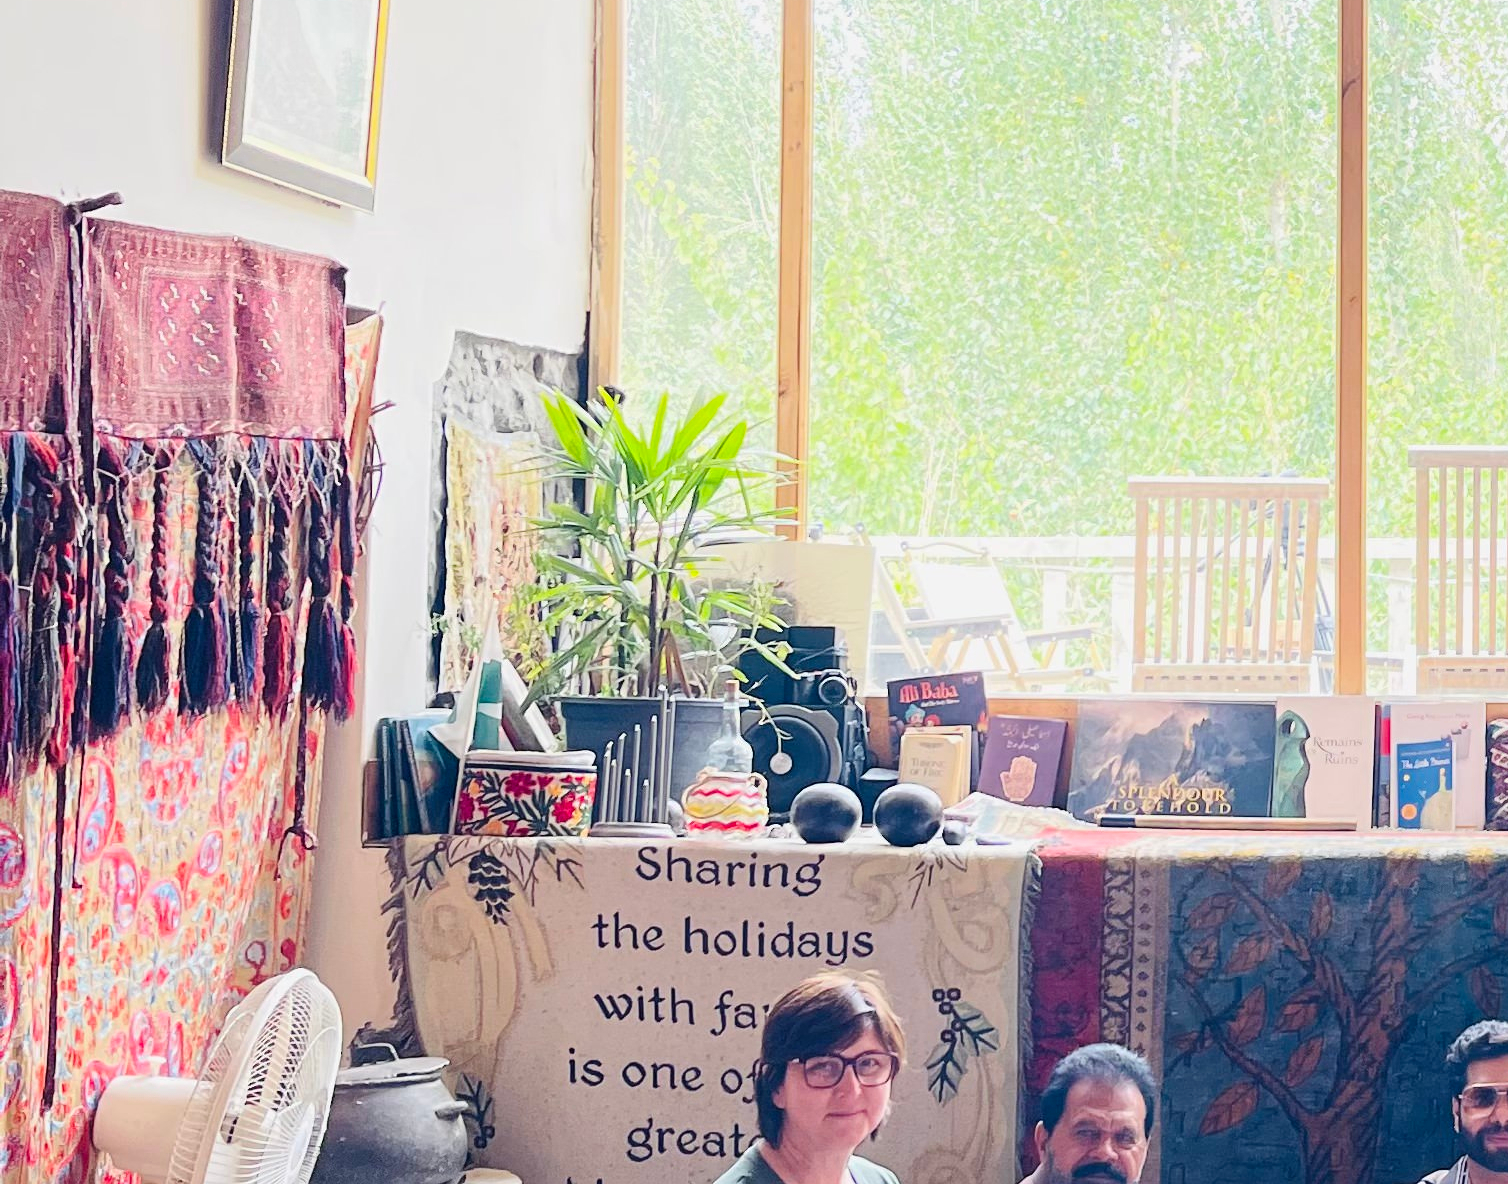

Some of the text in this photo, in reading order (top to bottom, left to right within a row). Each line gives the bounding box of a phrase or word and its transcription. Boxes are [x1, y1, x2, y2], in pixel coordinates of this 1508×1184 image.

[920, 681, 959, 699] Baba
[1313, 736, 1363, 748] Remains
[1324, 751, 1359, 765] Ruins
[1118, 785, 1228, 802] SPLENDOUR
[1111, 800, 1232, 814] TO BEHOLD
[636, 846, 825, 897] Sharing
[591, 912, 874, 966] the holidays
[594, 985, 769, 1036] with fa
[569, 1047, 760, 1104] is one of
